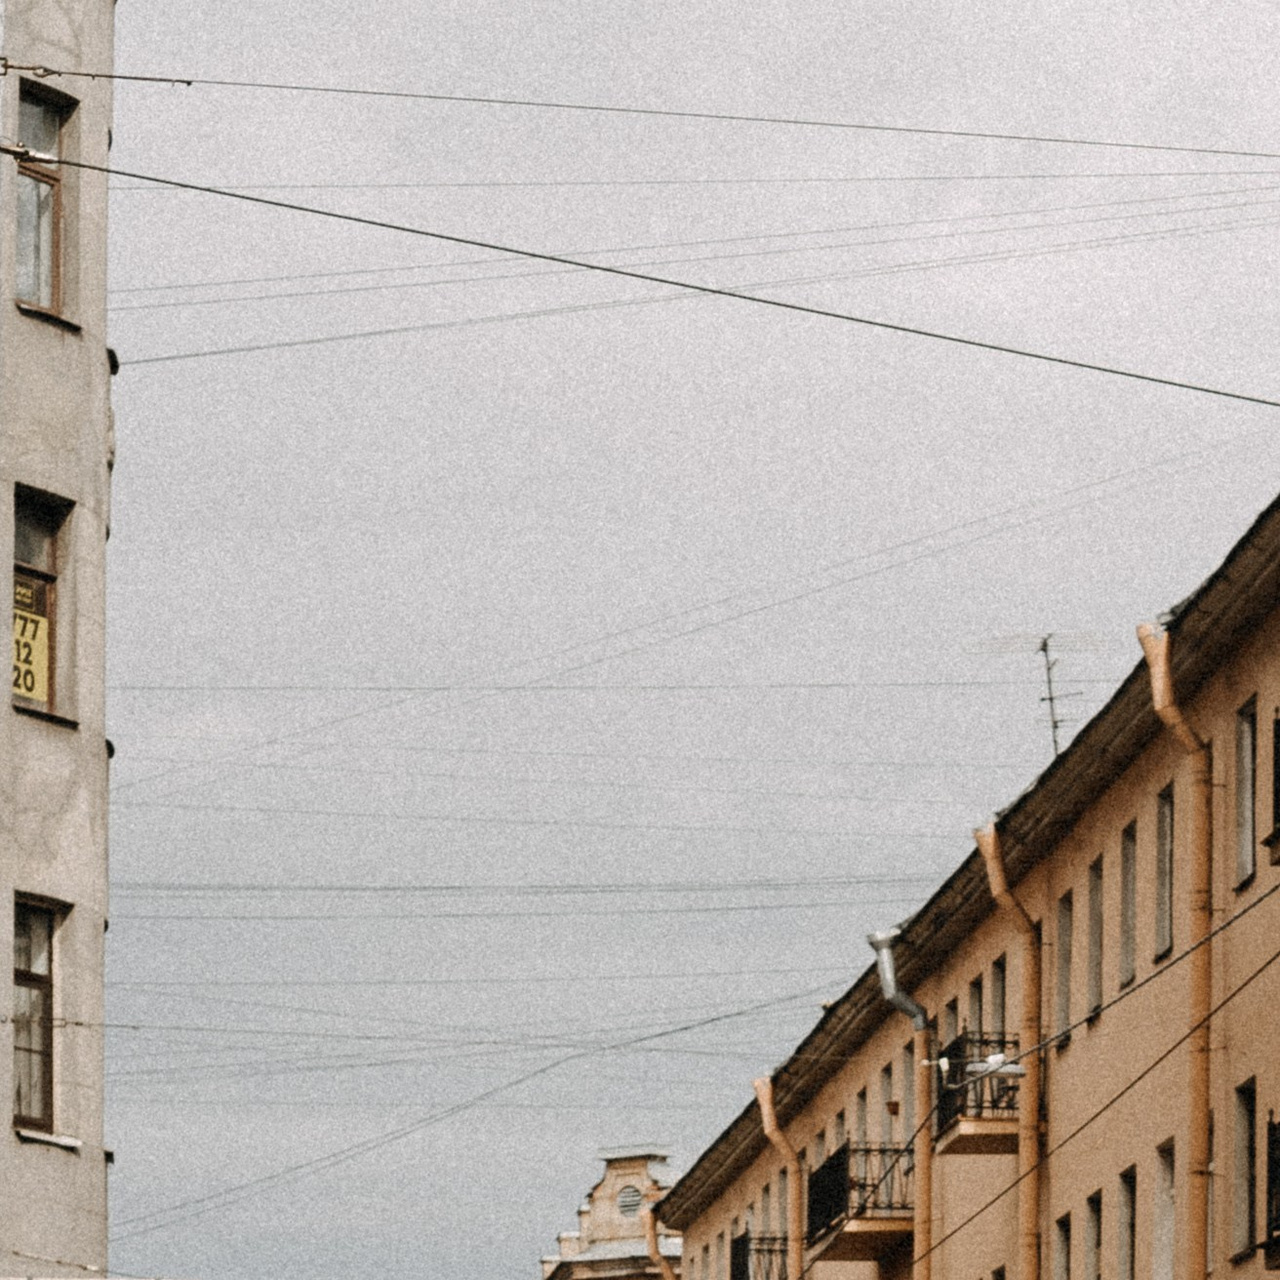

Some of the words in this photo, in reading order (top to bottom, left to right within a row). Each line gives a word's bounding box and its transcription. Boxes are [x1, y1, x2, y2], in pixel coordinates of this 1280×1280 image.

[14, 612, 40, 640] 77
[15, 639, 33, 666] 12
[13, 665, 36, 692] 20
